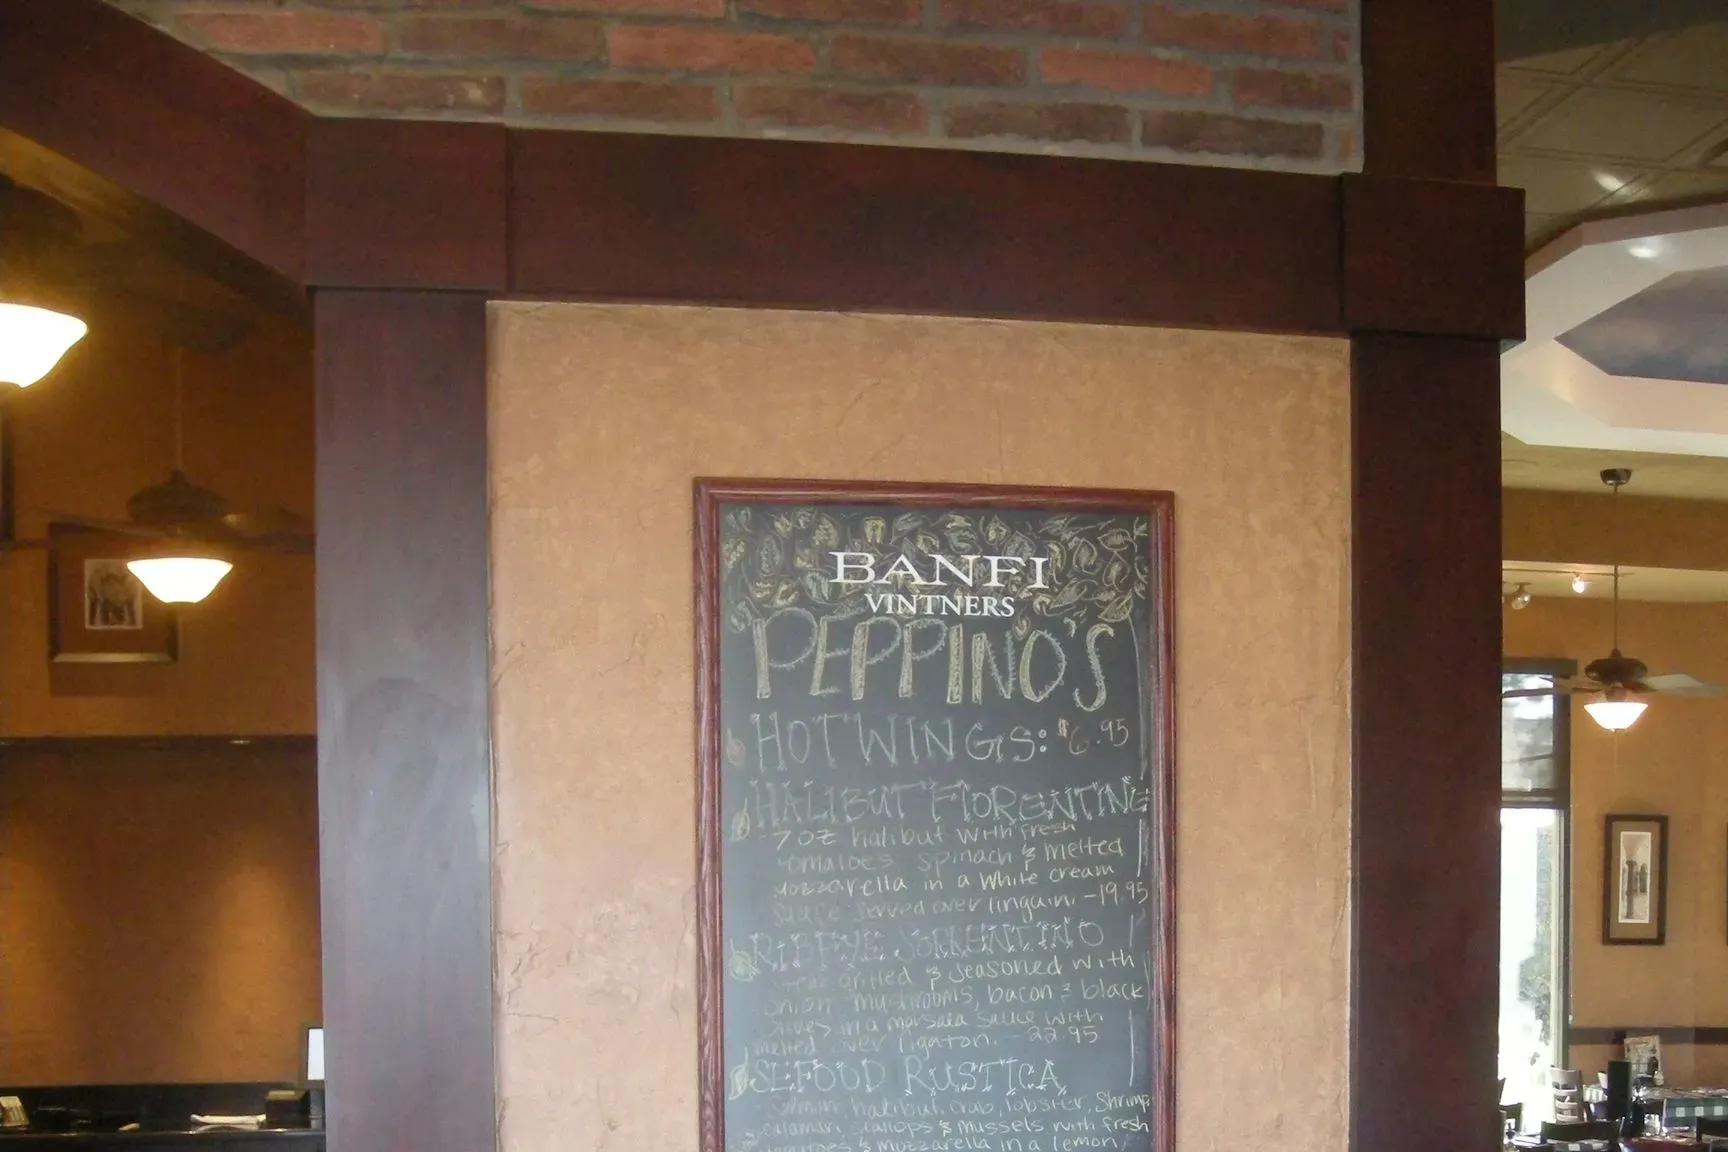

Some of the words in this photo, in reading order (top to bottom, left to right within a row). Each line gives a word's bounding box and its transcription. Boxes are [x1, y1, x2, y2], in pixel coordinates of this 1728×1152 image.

[829, 551, 1048, 588] BANFI
[865, 593, 1015, 617] VINTNERS
[750, 711, 851, 774] HOT
[748, 779, 926, 829] HALIBUT
[852, 824, 944, 848] halibut
[956, 823, 1012, 844] with
[777, 853, 897, 873] tomatoes
[917, 847, 1013, 877] spinach
[923, 875, 944, 891] in
[957, 875, 970, 889] a
[1049, 862, 1115, 883] cream
[932, 896, 981, 915] over
[838, 965, 912, 992] grilled
[1072, 949, 1136, 970] with
[988, 984, 1053, 1004] bacon
[1081, 977, 1145, 1000] black
[865, 1017, 880, 1032] a
[1045, 1008, 1104, 1026] with
[749, 1058, 886, 1093] SEFOOD
[904, 1055, 1067, 1097] RUSTICA
[1053, 1115, 1096, 1133] with
[1000, 1138, 1023, 1152] in
[1028, 1140, 1041, 1151] a
